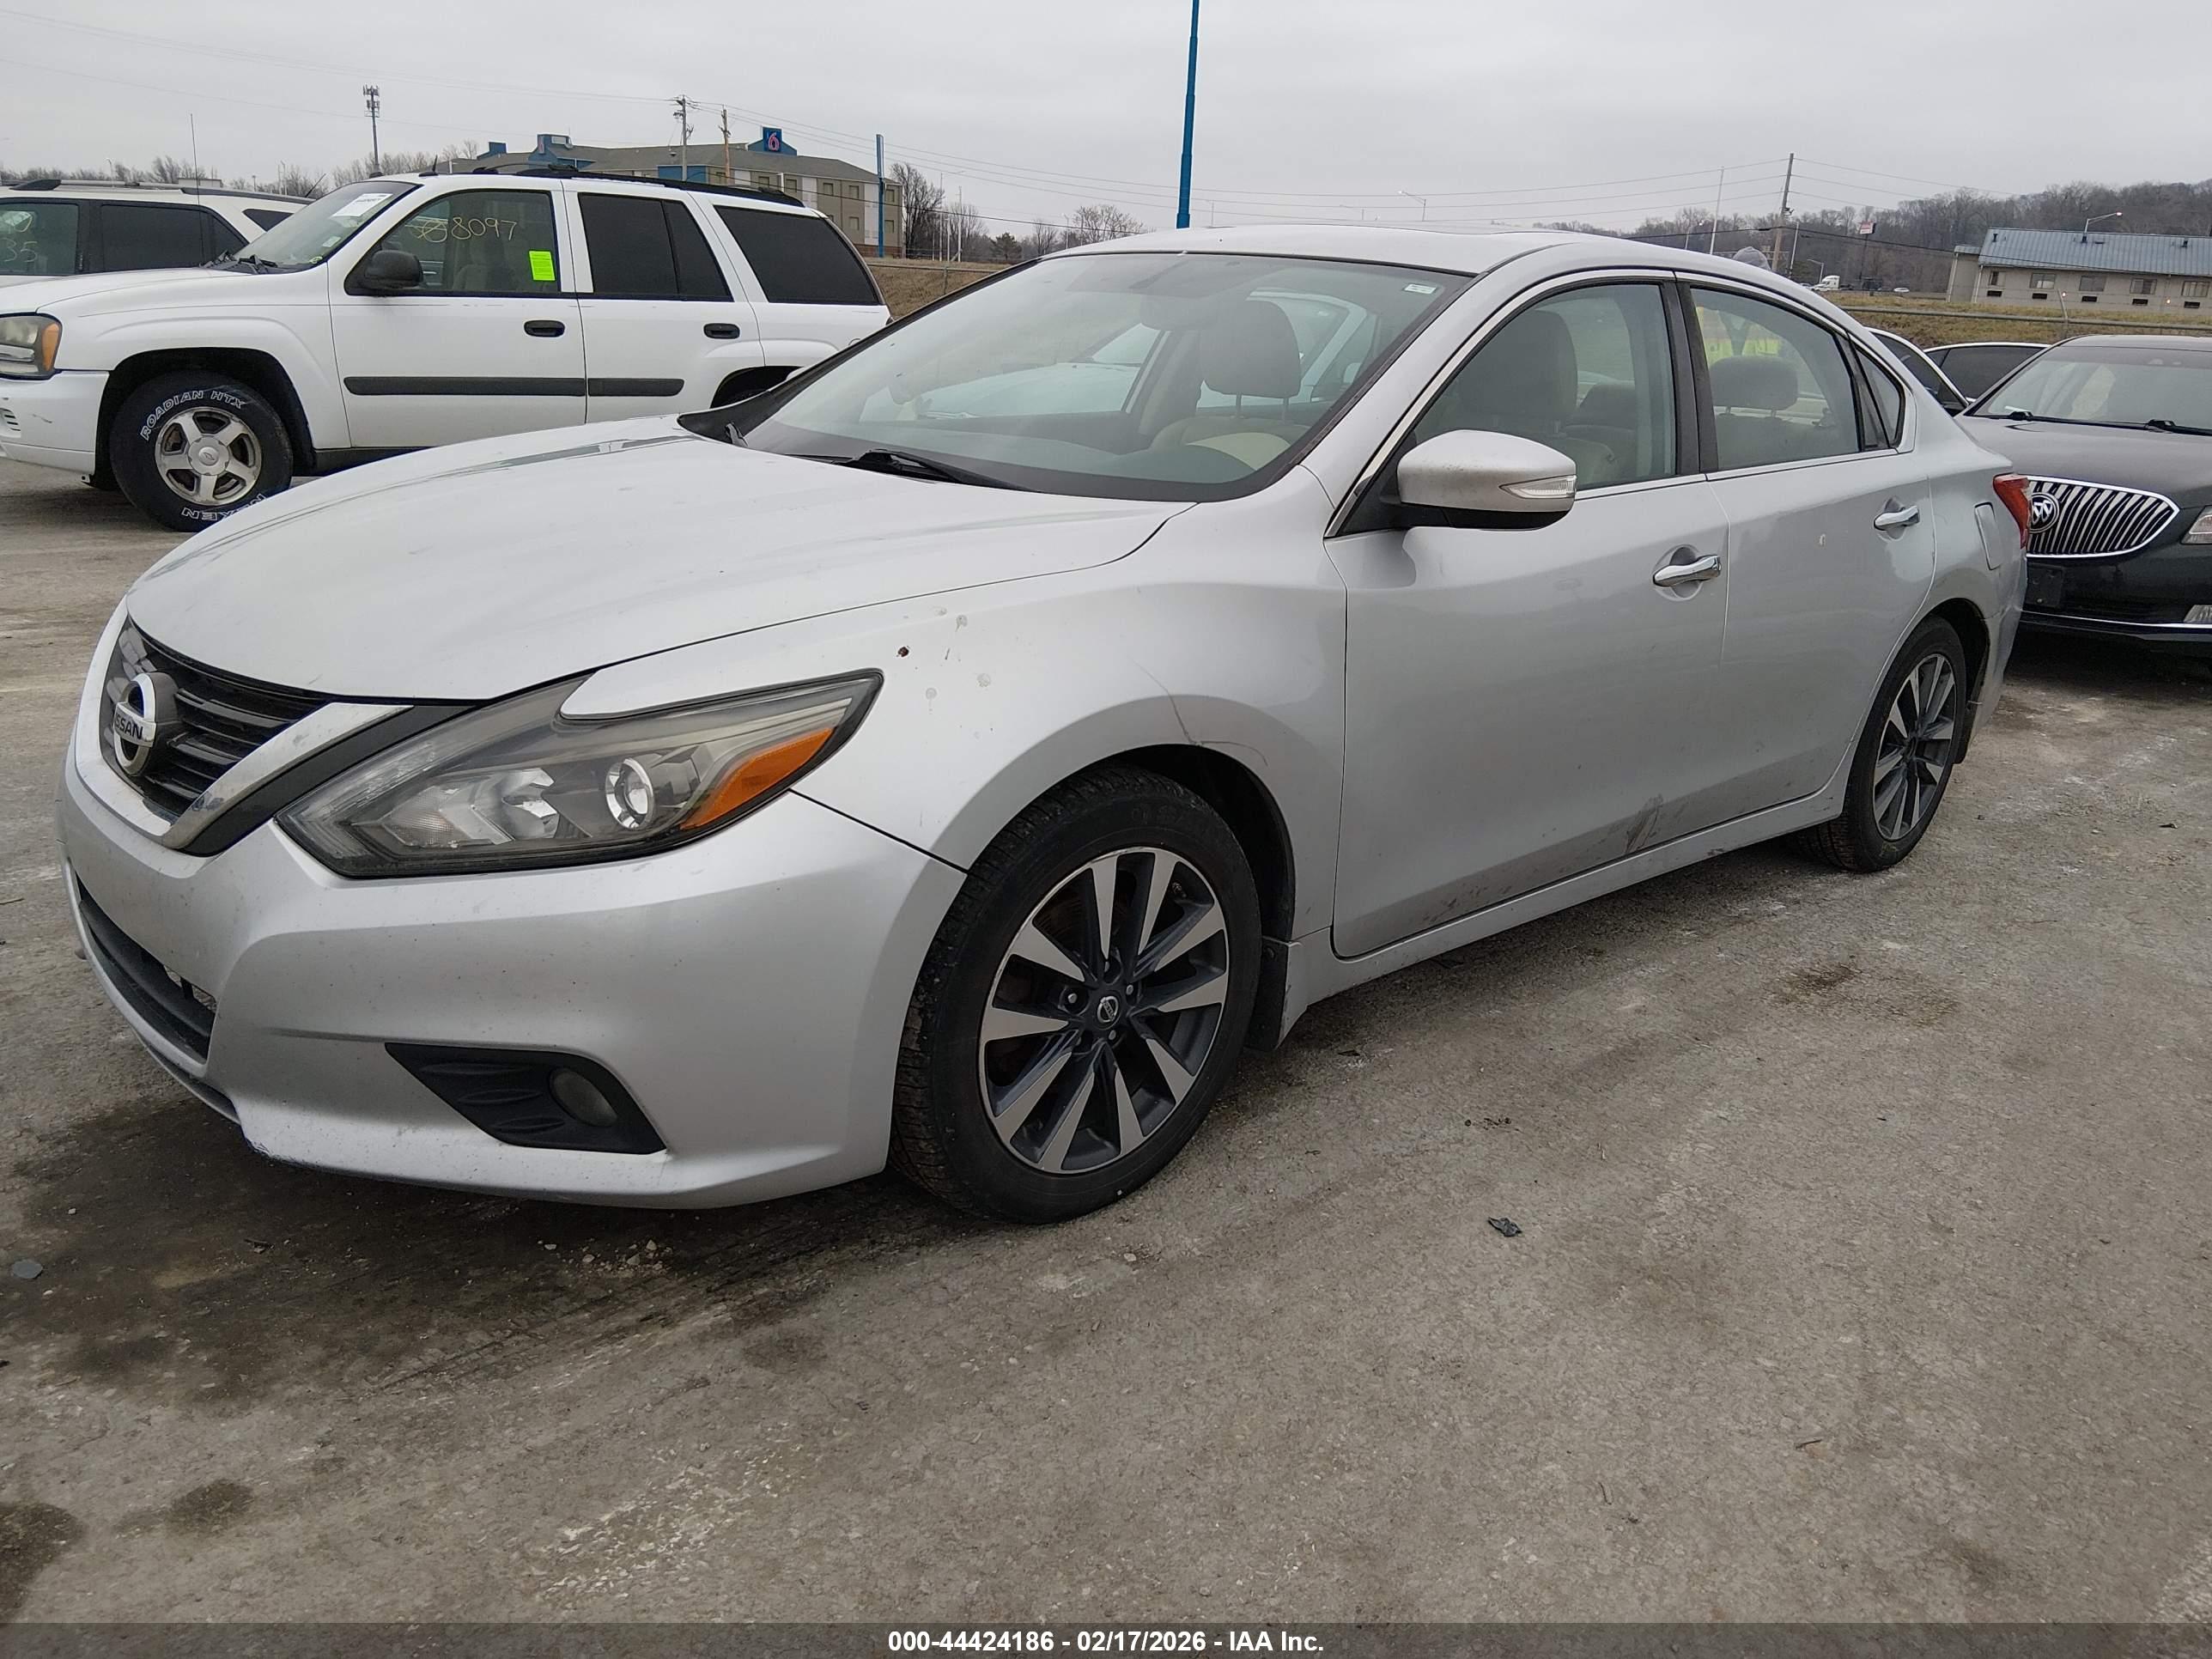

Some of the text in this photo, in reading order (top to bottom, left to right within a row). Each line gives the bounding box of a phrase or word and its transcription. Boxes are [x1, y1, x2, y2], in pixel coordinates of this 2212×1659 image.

[768, 131, 780, 152] 6
[140, 390, 246, 441] ROADIAN HTX
